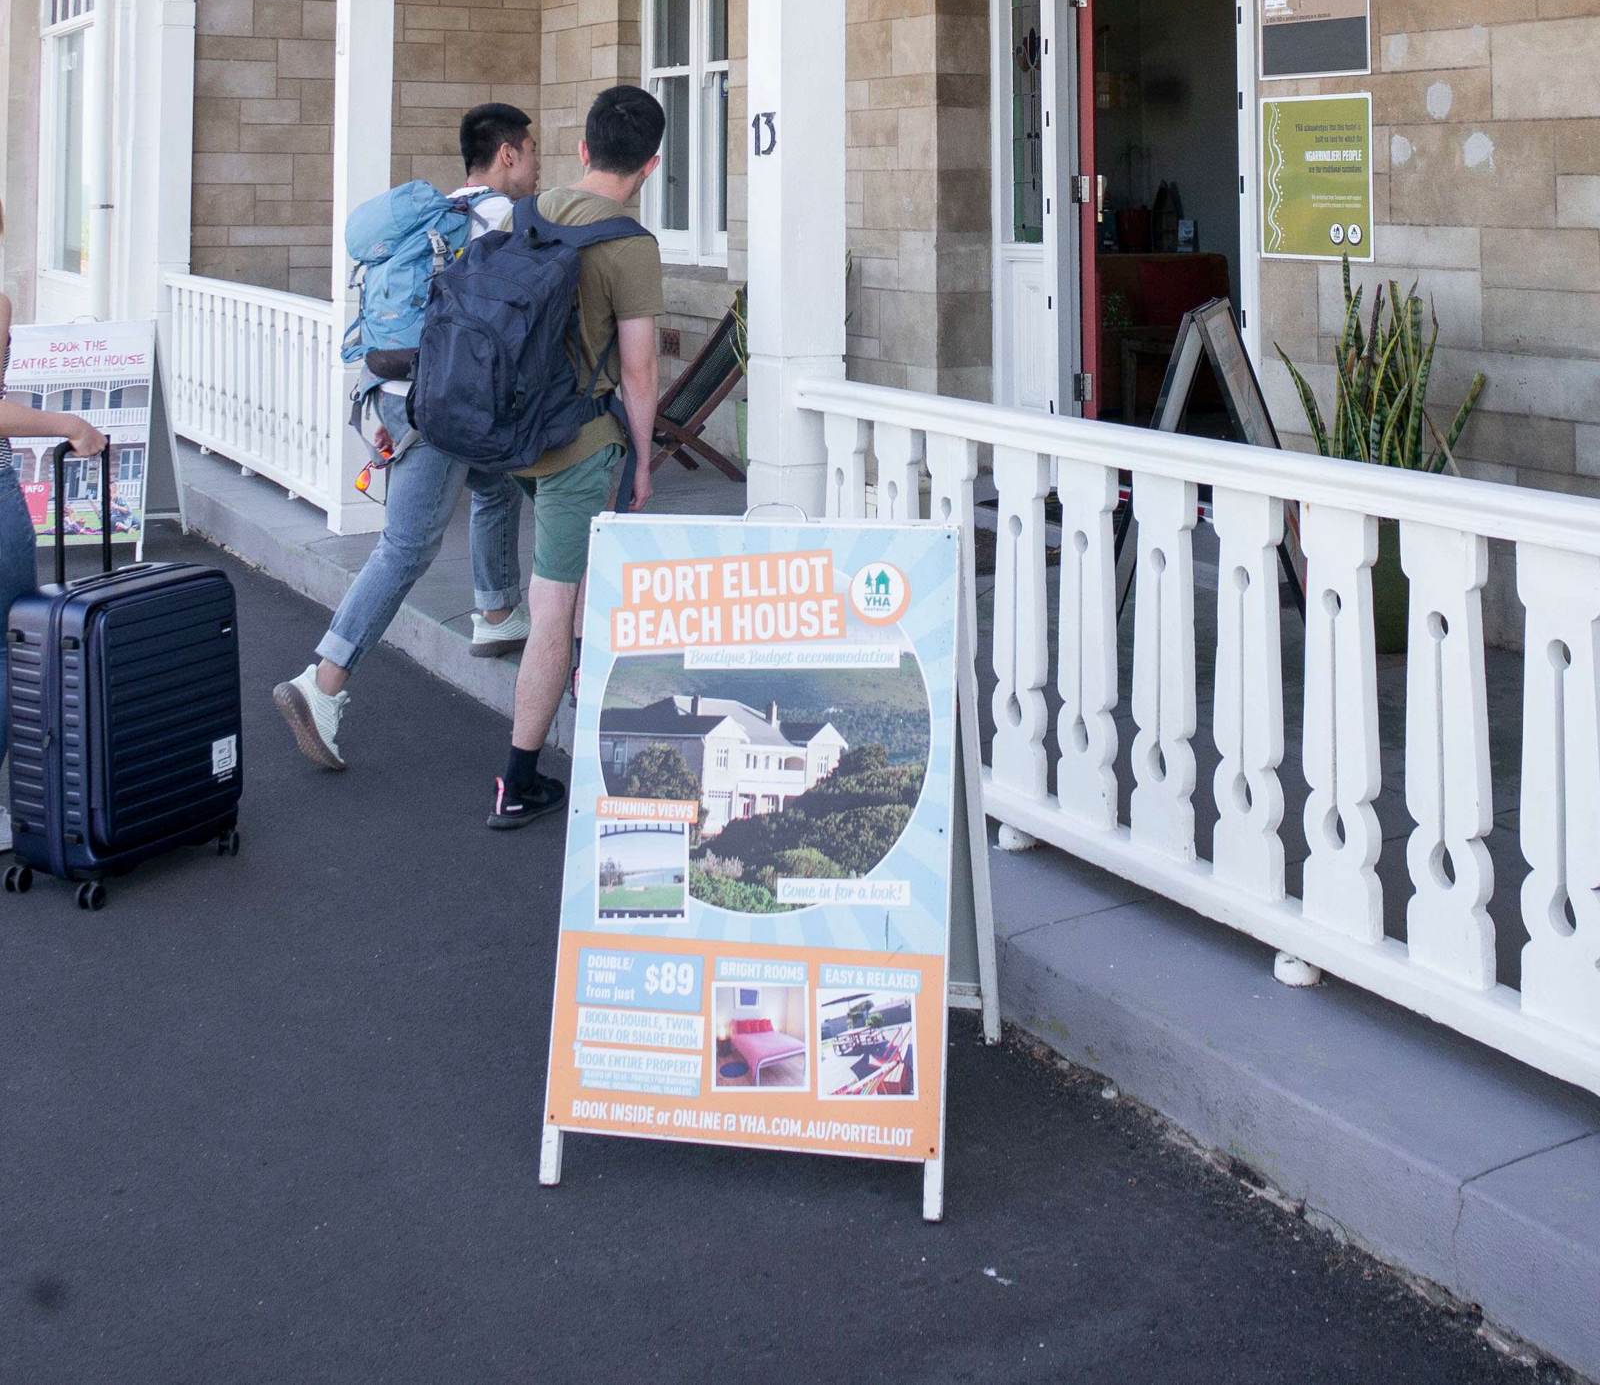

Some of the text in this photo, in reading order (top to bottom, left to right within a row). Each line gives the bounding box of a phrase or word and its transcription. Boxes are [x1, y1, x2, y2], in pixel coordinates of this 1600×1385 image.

[751, 111, 777, 156] 13
[50, 340, 107, 353] BOOK THE
[12, 354, 145, 370] ENTIRE BEACH HOUSE
[631, 556, 828, 604] PORT ELLIOT
[865, 596, 891, 607] YHA
[616, 599, 840, 648] BEACH HOUSE
[689, 648, 745, 666] Boutique
[748, 648, 794, 666] Budget
[600, 800, 694, 819] STUNNING VIEWS
[782, 882, 903, 901] Come in for a look!
[587, 954, 635, 971] DOUBLE/
[720, 961, 804, 981] BRIGHT ROOMS
[587, 970, 616, 984] TWIN
[644, 962, 695, 996] $89
[825, 968, 918, 989] EASY & RELAXED
[585, 985, 635, 1001] from just
[585, 1011, 610, 1025] BOOK
[611, 1014, 618, 1025] A
[579, 1026, 698, 1047] FAMILY OR SHARE ROOM
[578, 1052, 699, 1074] BOOK ENTIRE PROPERTY
[571, 1099, 914, 1147] BOOK INSIDE or ONLINE @ YHA.COM.AU/PORTELLIOT
